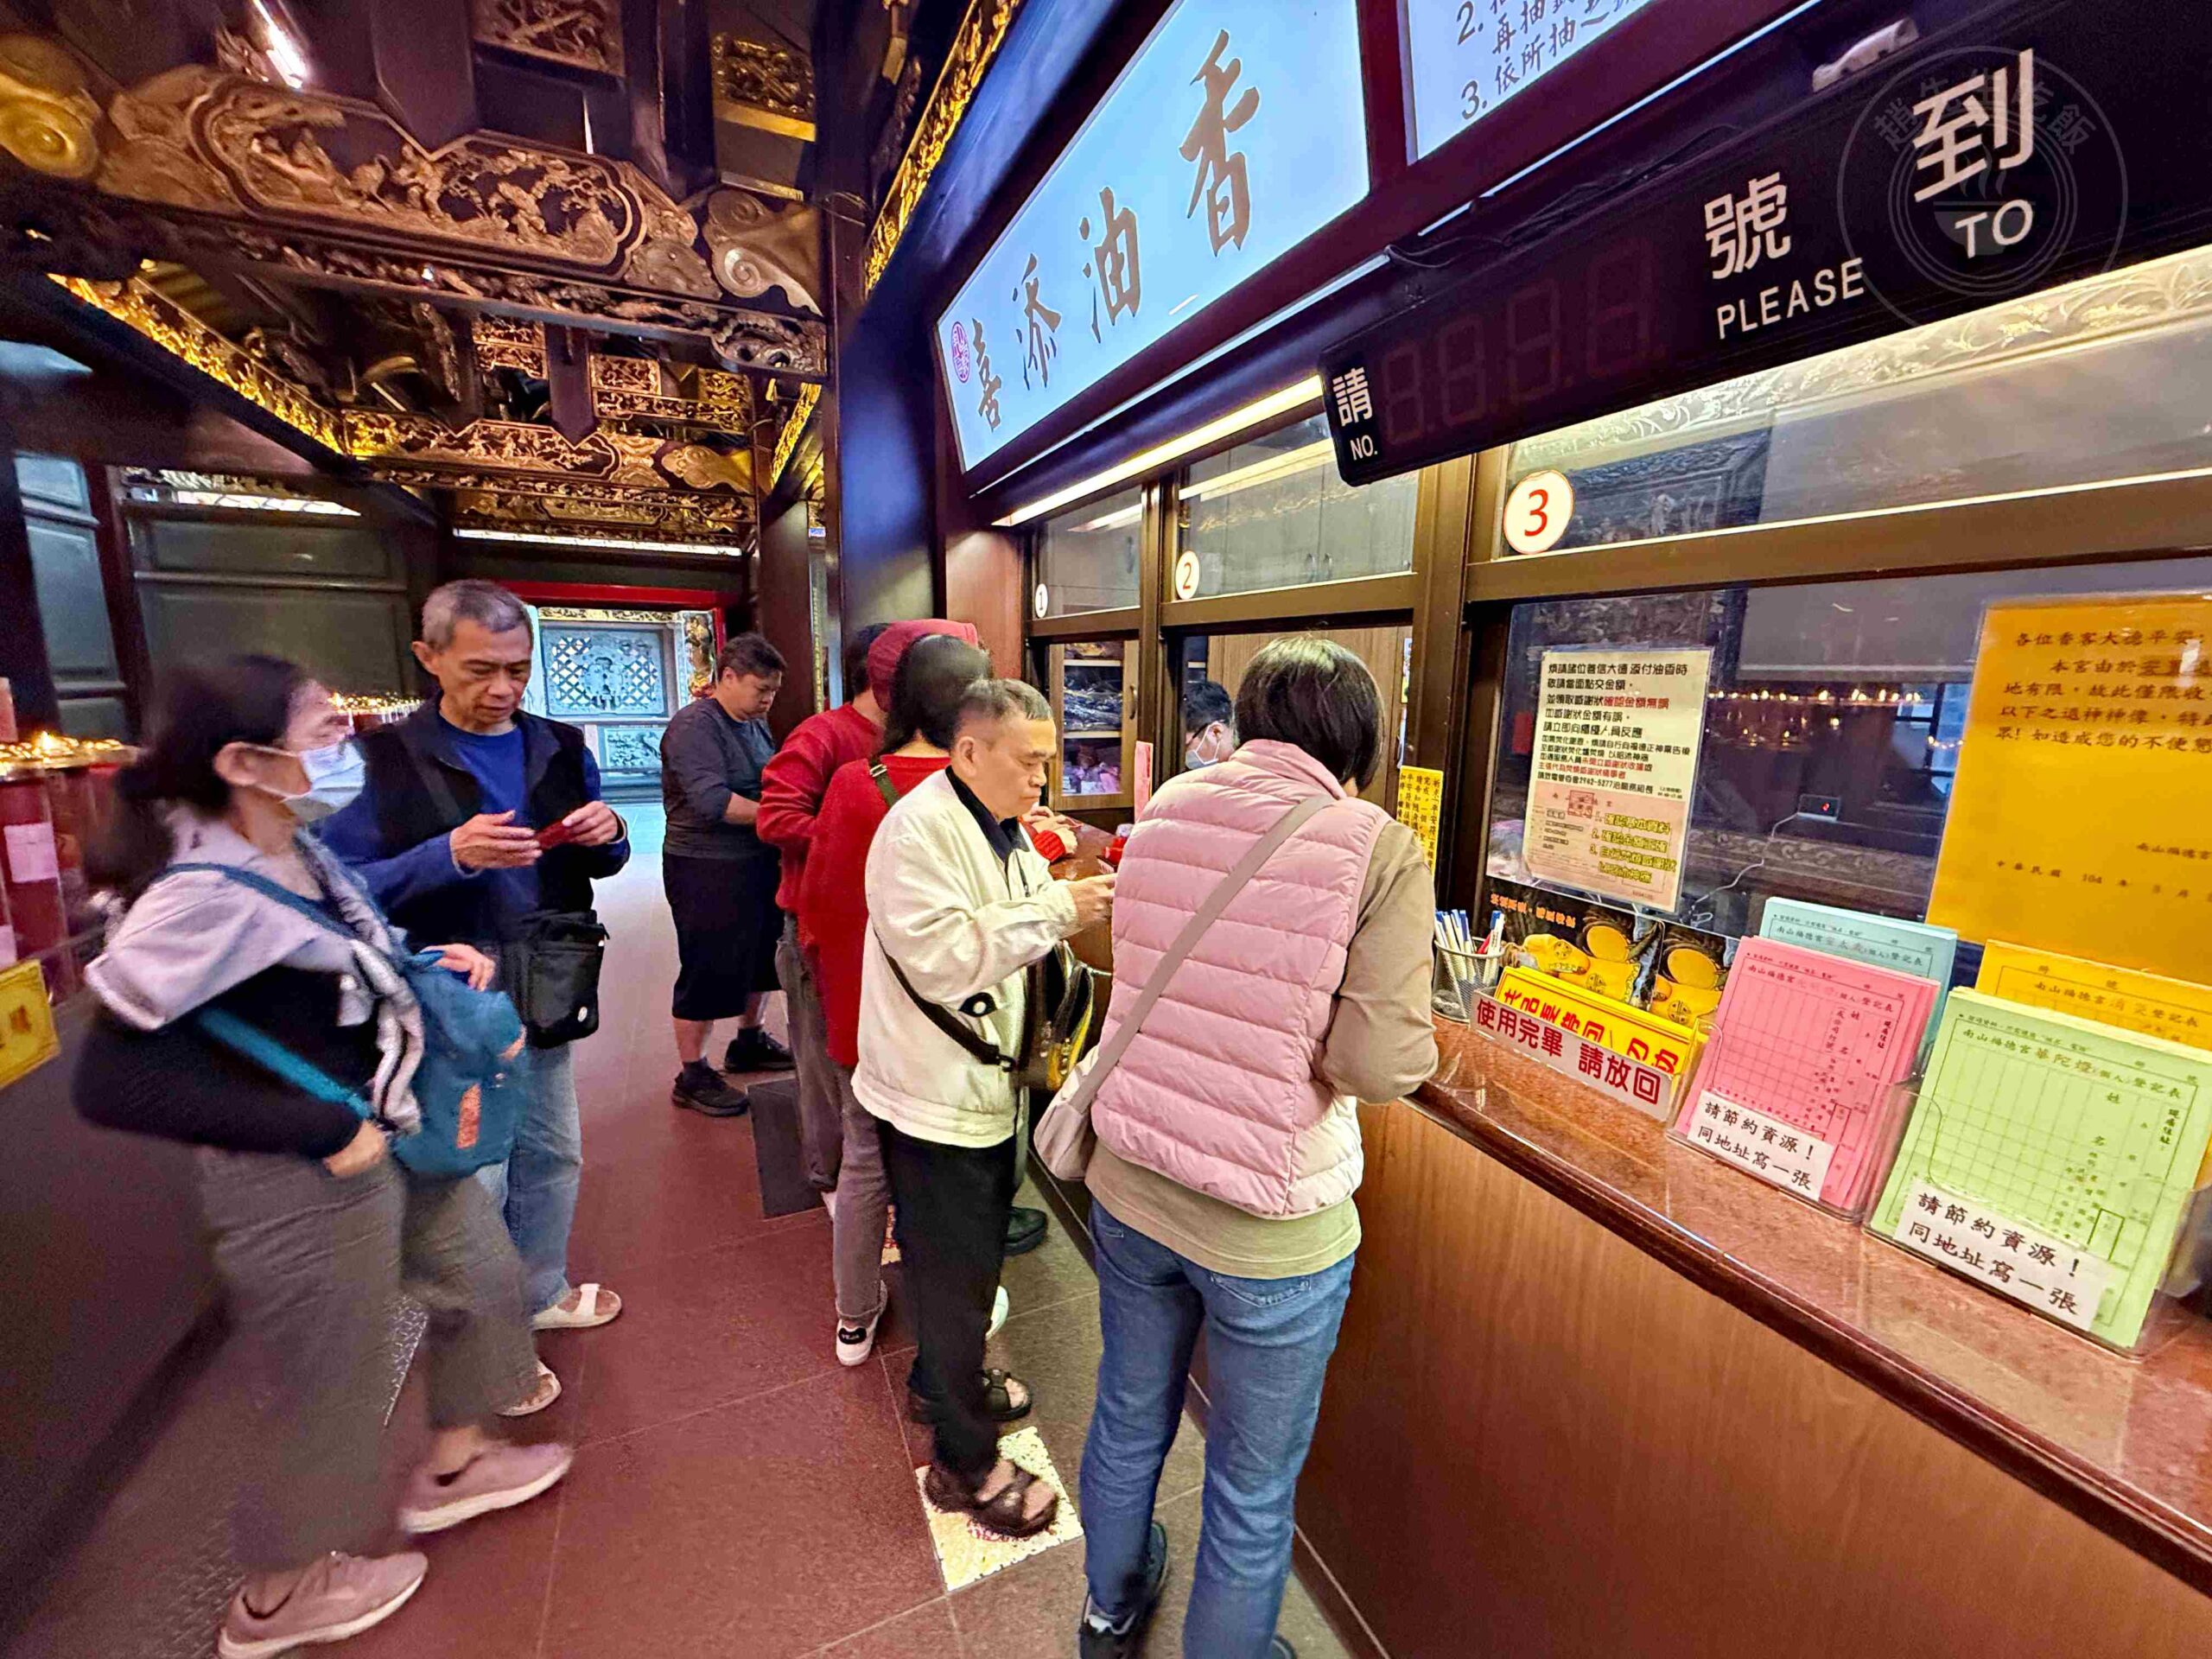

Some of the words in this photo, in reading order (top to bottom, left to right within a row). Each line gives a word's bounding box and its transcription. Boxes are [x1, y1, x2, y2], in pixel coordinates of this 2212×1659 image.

[1460, 79, 1488, 121] 3.
[1494, 0, 1641, 96] 依所抽之
[1332, 366, 1373, 427] 請
[1703, 171, 1791, 280] 號
[1913, 48, 2034, 202] 到
[1350, 434, 1378, 461] NO.
[1716, 257, 1865, 340] PLEASE
[1955, 199, 2033, 258] TO
[1523, 488, 1549, 537] 3
[1182, 562, 1192, 590] 2
[1476, 997, 1564, 1059] 使用完畢
[1578, 1041, 1662, 1105] 請放回
